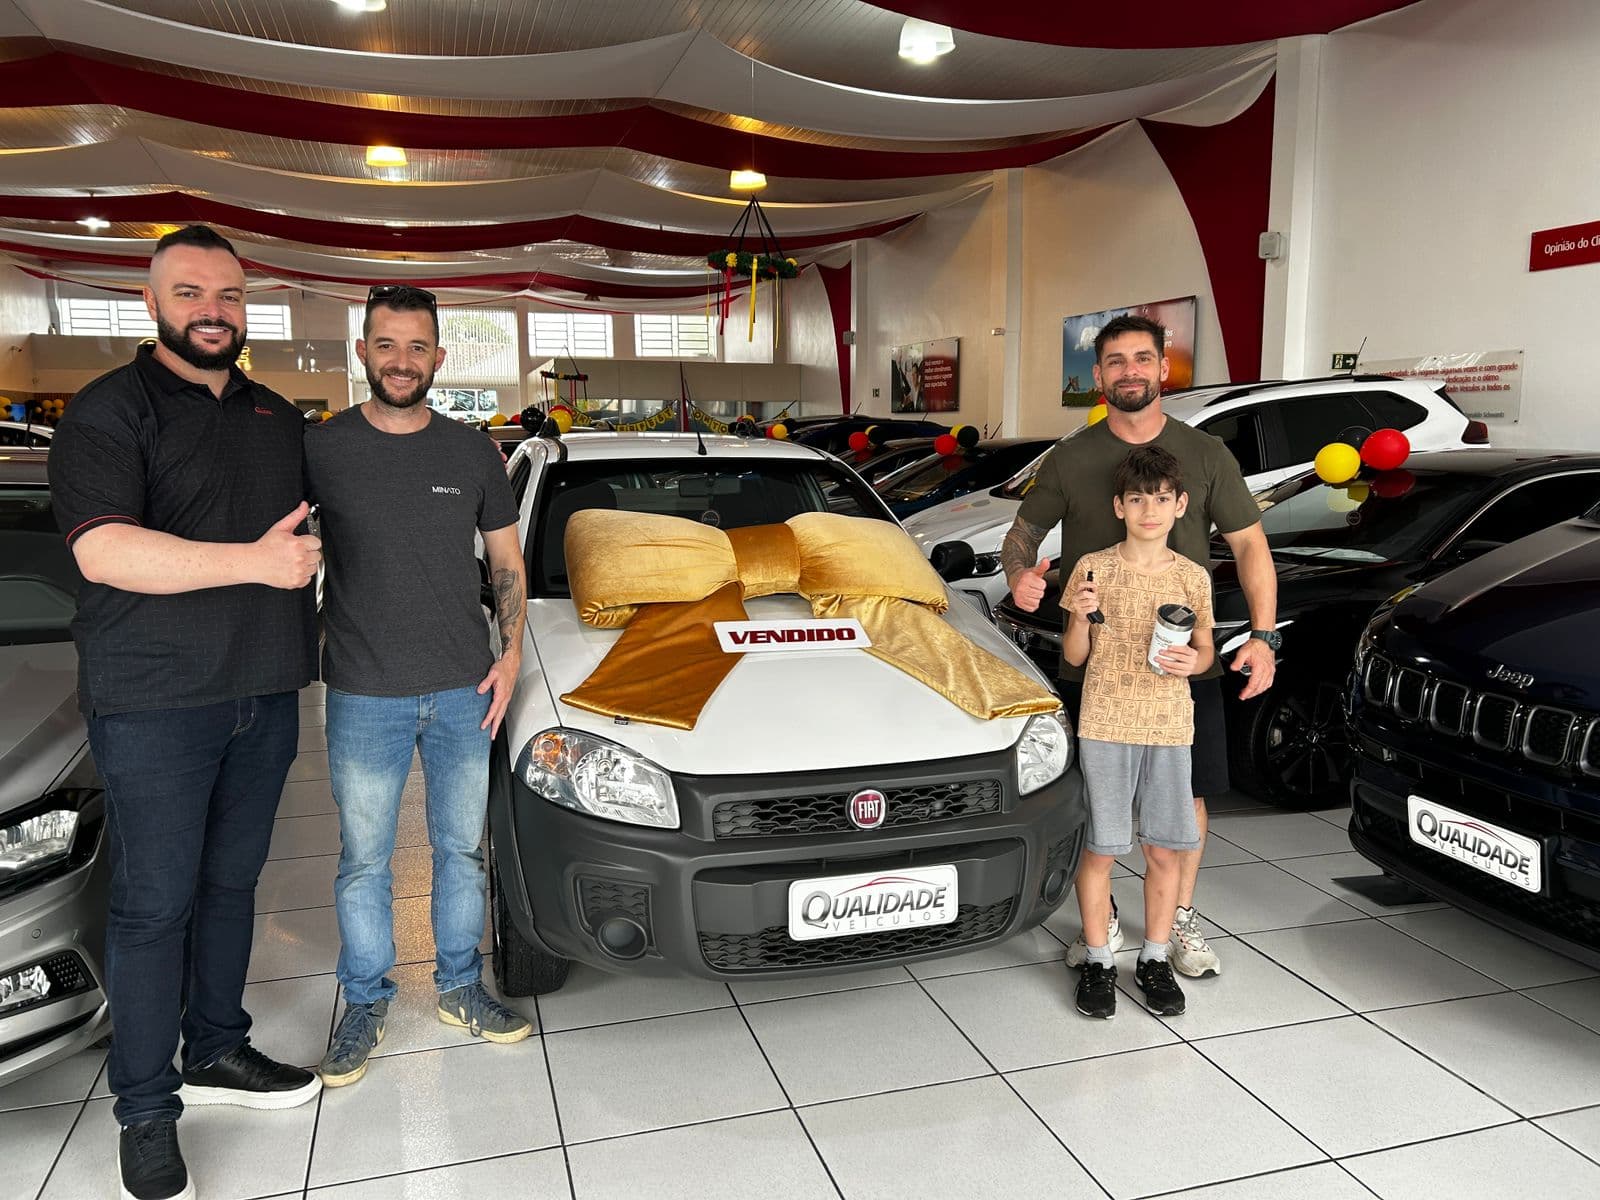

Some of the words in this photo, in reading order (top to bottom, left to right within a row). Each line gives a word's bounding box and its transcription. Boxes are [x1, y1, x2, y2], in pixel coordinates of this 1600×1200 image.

[1544, 240, 1576, 256] Opinião
[1577, 237, 1589, 249] do
[1497, 361, 1518, 373] grande
[1445, 374, 1472, 384] dedicação
[431, 486, 461, 495] MINATO
[728, 627, 856, 645] VENDIDO
[1486, 664, 1534, 688] Jeep
[858, 800, 879, 819] FIAT
[1417, 809, 1531, 875] QUALIDADE
[801, 886, 947, 930] QUALIDADE
